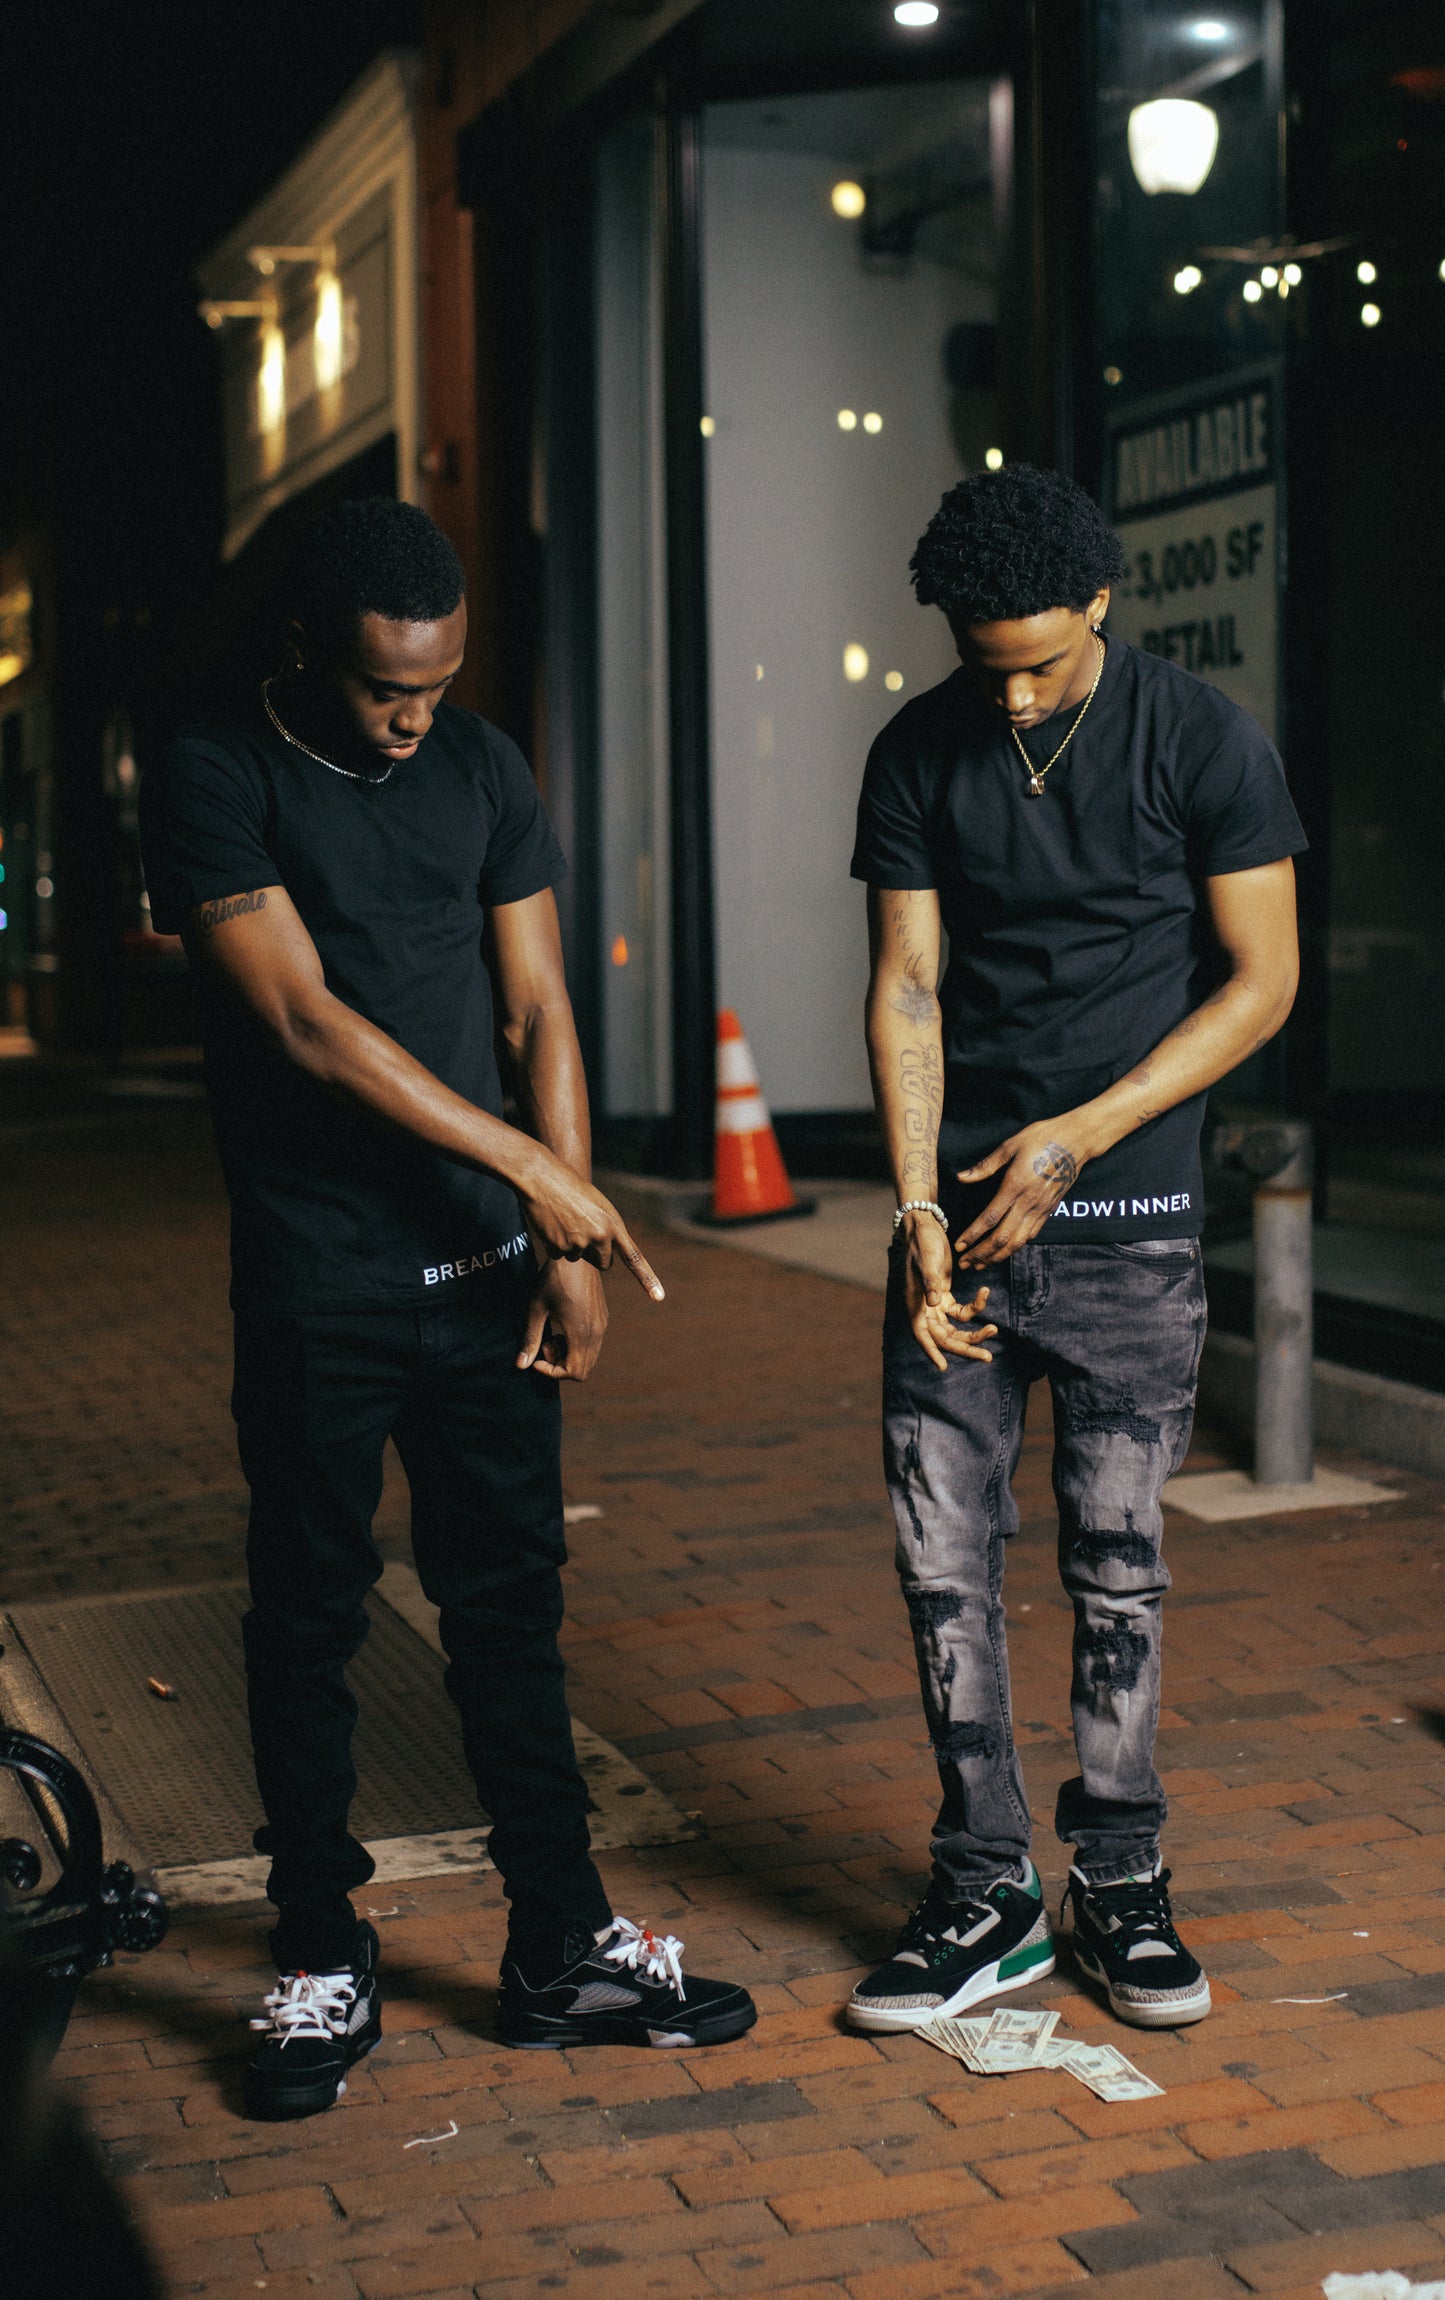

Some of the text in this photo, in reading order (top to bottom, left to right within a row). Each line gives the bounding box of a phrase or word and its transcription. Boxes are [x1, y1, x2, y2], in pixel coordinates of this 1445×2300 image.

[1116, 392, 1268, 511] AVAILABLE
[1226, 523, 1265, 580] SF
[1049, 1193, 1191, 1218] ADW1NNER
